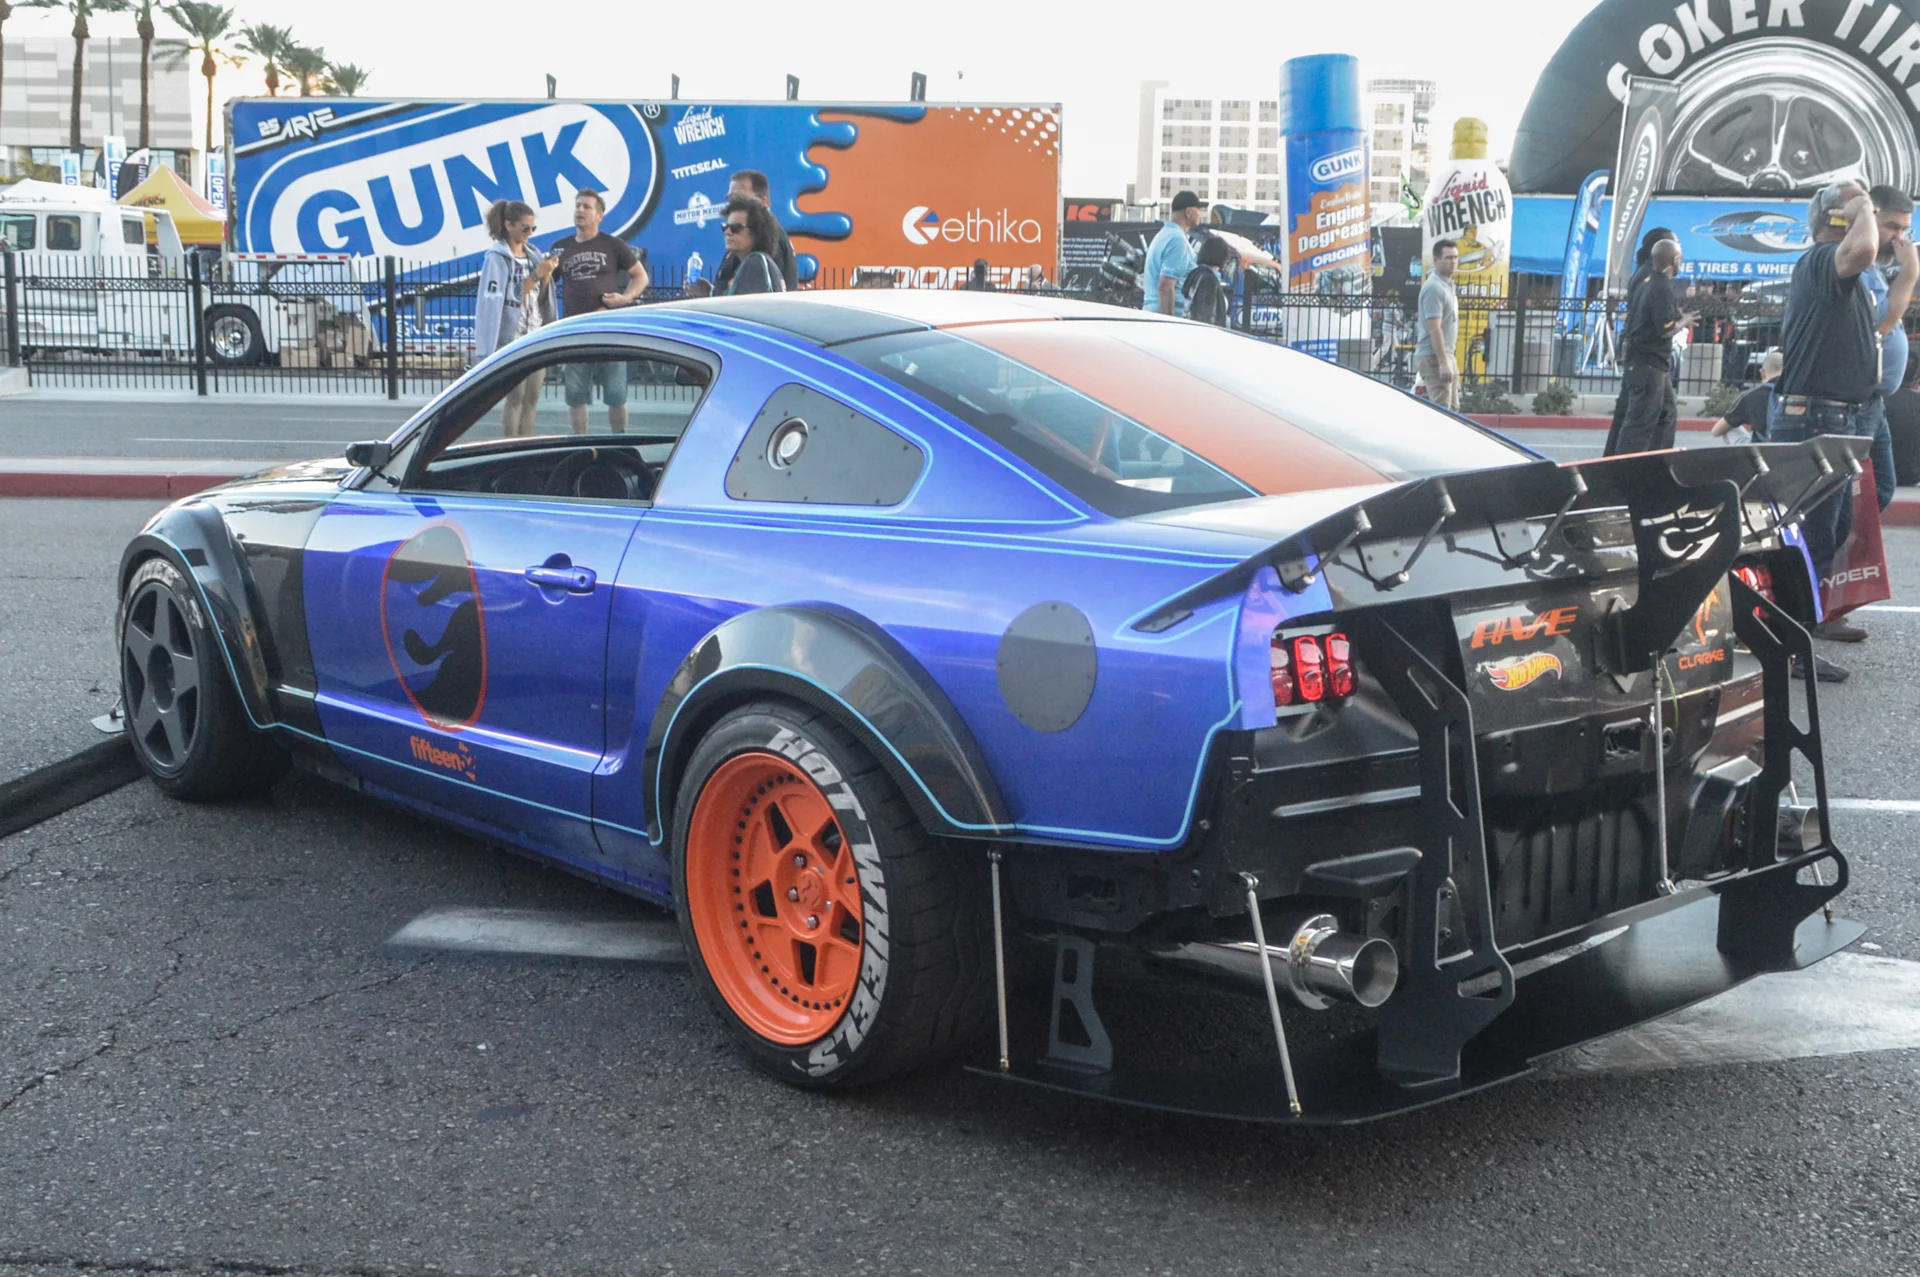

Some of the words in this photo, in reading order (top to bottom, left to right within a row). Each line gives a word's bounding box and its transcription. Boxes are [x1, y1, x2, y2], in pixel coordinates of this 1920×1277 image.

[1834, 0, 1920, 114] TIR
[673, 116, 726, 145] WRENCH
[677, 105, 713, 126] Liquid
[671, 158, 727, 180] TITESEAL
[1317, 153, 1363, 177] GUNK
[1635, 143, 1650, 181] ARC
[296, 118, 610, 256] GUNK
[1432, 170, 1489, 204] Liquid
[941, 207, 1042, 243] ethika
[1315, 203, 1366, 230] Engine
[1427, 188, 1507, 238] WRENCH
[1616, 187, 1639, 242] AUDIO
[1311, 242, 1368, 268] ORIGINAL
[1698, 262, 1739, 273] TIRES
[1742, 262, 1753, 273] &
[1757, 263, 1796, 275] WHEE
[1507, 662, 1529, 688] HOT
[1528, 655, 1558, 681] WHEELS
[1678, 648, 1725, 670] CLARKE
[766, 725, 867, 825] HOT
[805, 822, 890, 1078] WHEELS
